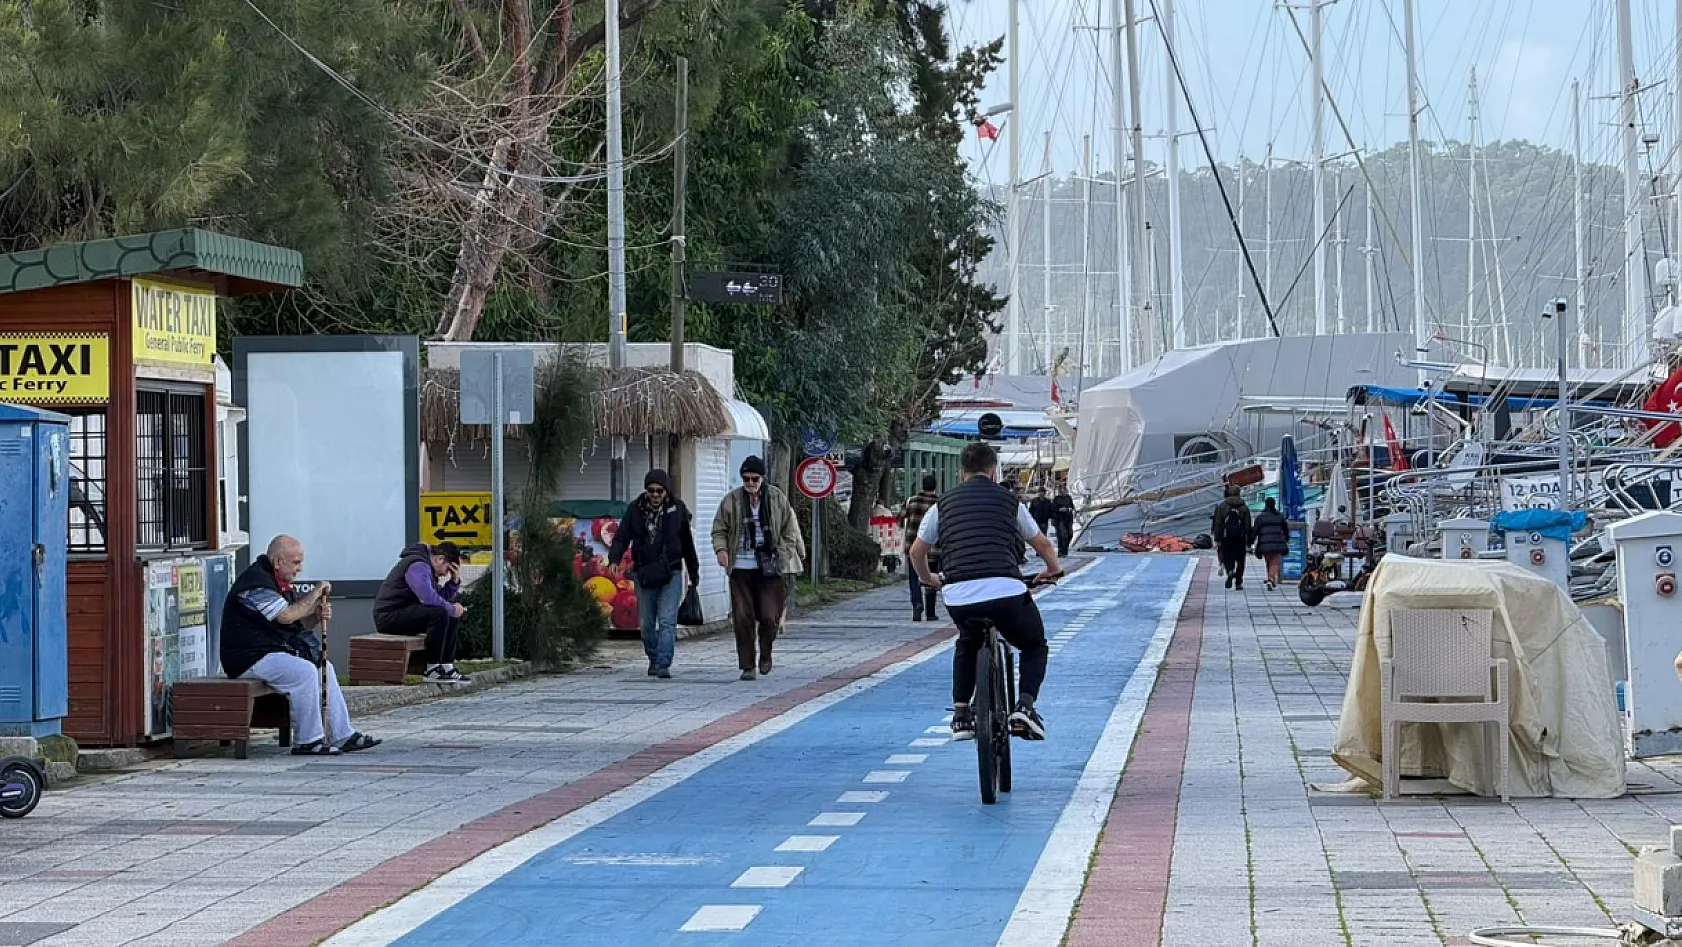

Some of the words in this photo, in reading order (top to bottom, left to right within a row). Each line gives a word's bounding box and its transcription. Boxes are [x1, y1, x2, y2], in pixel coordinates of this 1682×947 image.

[135, 285, 181, 334] WATER
[184, 294, 211, 337] TAXI
[145, 332, 170, 352] General
[190, 337, 206, 359] Ferry
[0, 344, 91, 375] TAXI
[13, 377, 68, 394] Ferry
[1508, 484, 1524, 497] 12
[1529, 479, 1594, 495] ADAAR
[424, 503, 490, 527] TAXI
